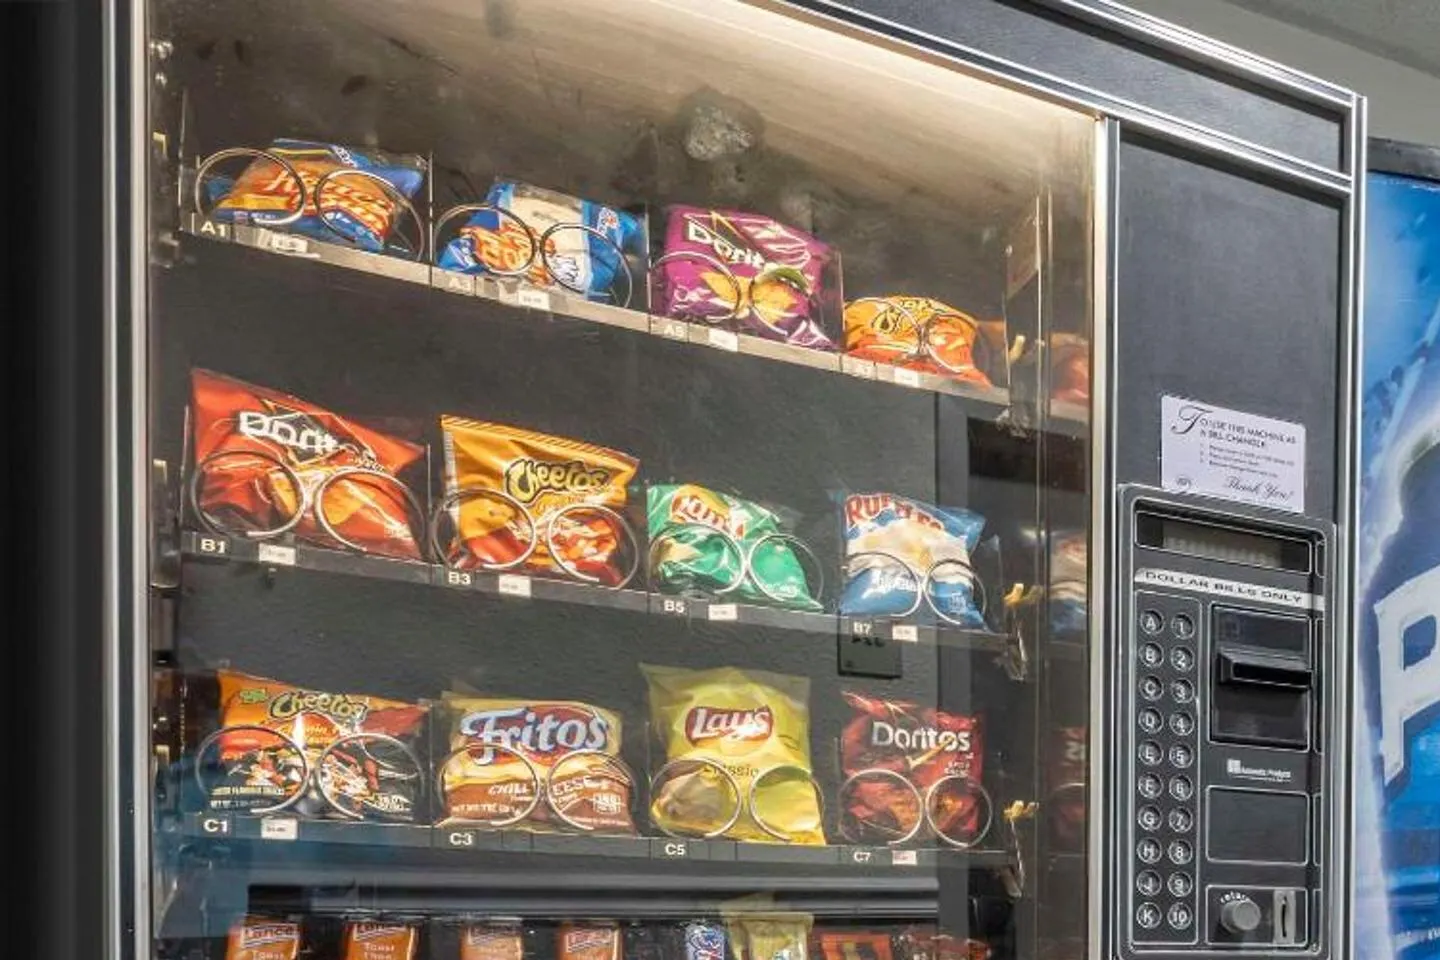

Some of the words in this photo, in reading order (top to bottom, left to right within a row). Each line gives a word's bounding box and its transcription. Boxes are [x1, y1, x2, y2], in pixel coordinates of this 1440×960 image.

[201, 221, 226, 238] A1
[505, 459, 608, 504] Cheetos
[201, 538, 226, 554] B1
[449, 571, 472, 585] B3
[1145, 571, 1209, 589] DOLLAR
[1214, 583, 1257, 597] BILLS
[1261, 591, 1304, 604] ONLY
[664, 600, 685, 613] B5
[853, 621, 872, 634] B7
[270, 692, 368, 721] Cheetos
[691, 707, 770, 739] Lay's
[460, 707, 608, 765] Fritos
[873, 720, 971, 752] Doritos
[203, 818, 228, 833] C1
[450, 832, 473, 847] C3
[665, 843, 685, 857] C5
[853, 851, 871, 862] C7
[244, 925, 296, 941] Lance
